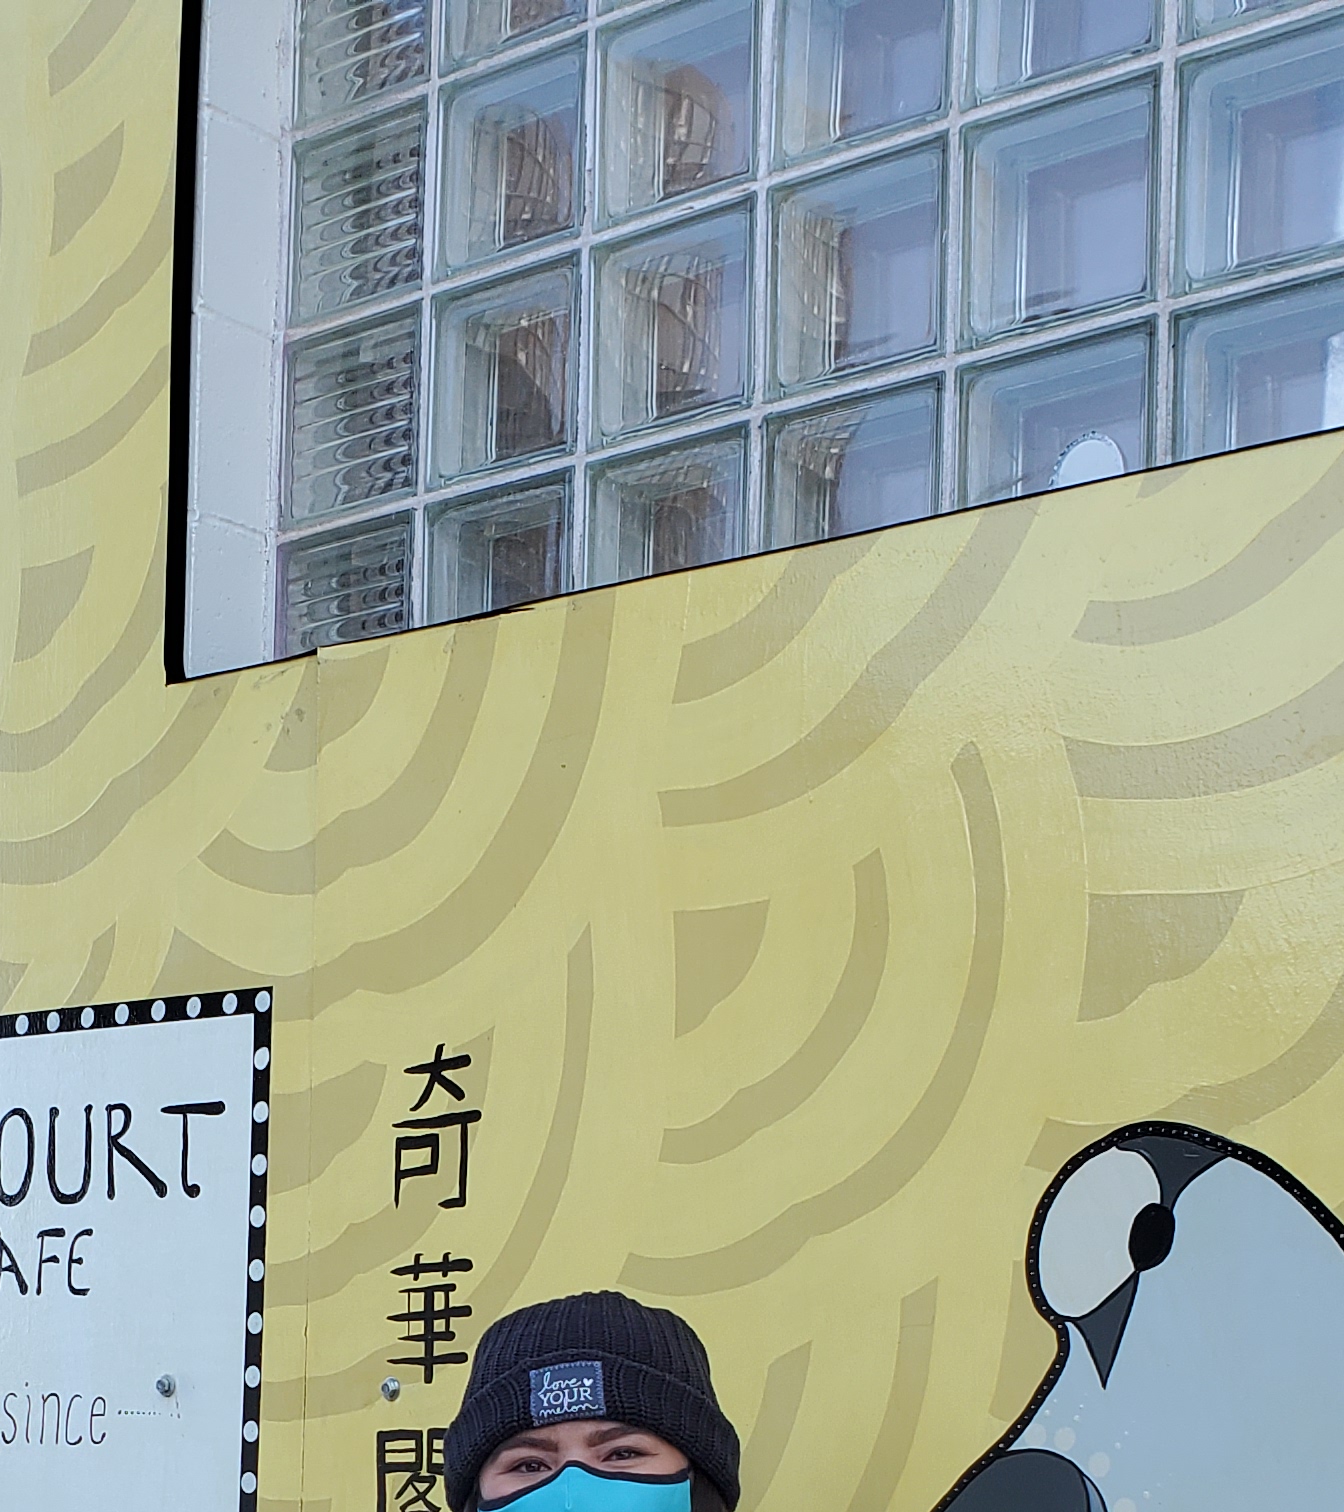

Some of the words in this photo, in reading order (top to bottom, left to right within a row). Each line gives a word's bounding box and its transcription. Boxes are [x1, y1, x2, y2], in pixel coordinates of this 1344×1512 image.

[538, 1371, 581, 1396] love
[539, 1387, 593, 1407] YOUR
[539, 1398, 599, 1418] melon
[0, 1382, 108, 1448] since
